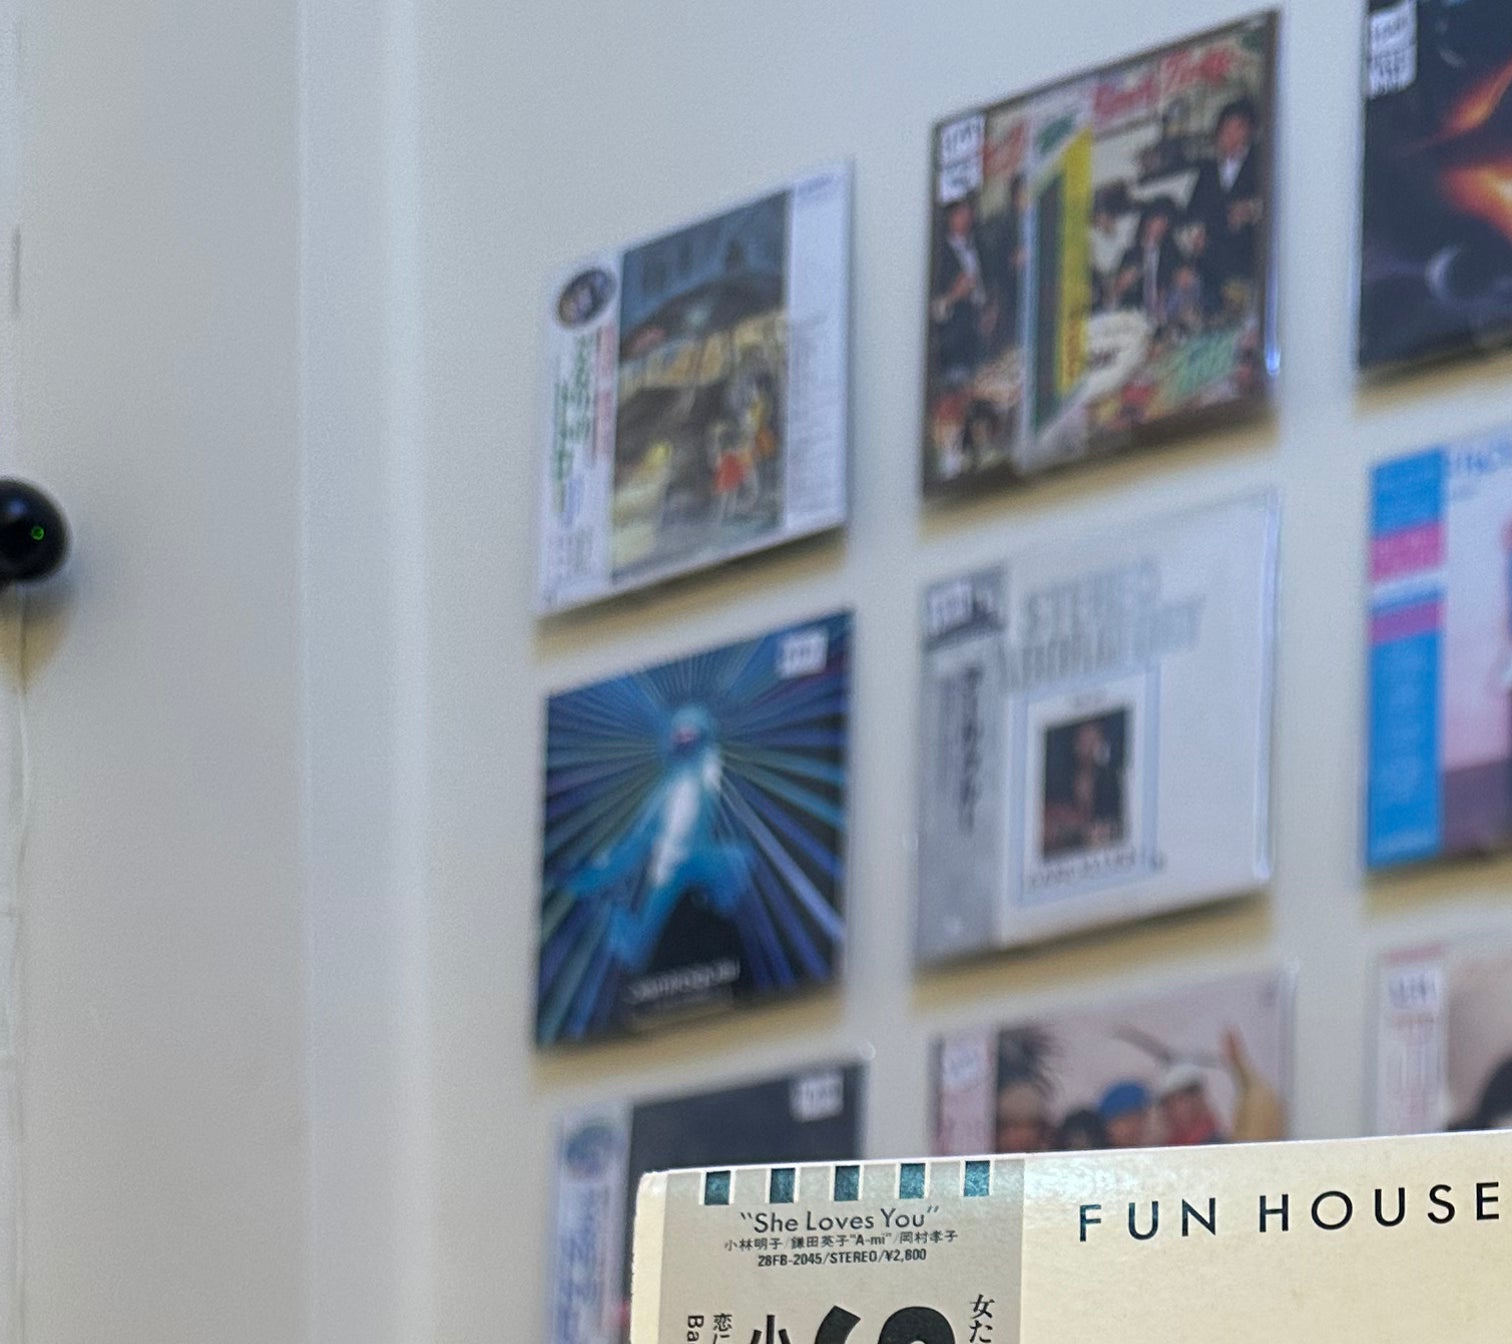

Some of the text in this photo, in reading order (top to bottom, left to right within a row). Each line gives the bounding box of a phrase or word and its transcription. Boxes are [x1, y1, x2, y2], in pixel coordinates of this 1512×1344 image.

[804, 1209, 876, 1233] Loves
[1078, 1197, 1217, 1243] FUN
[1258, 1180, 1501, 1233] HOUSE
